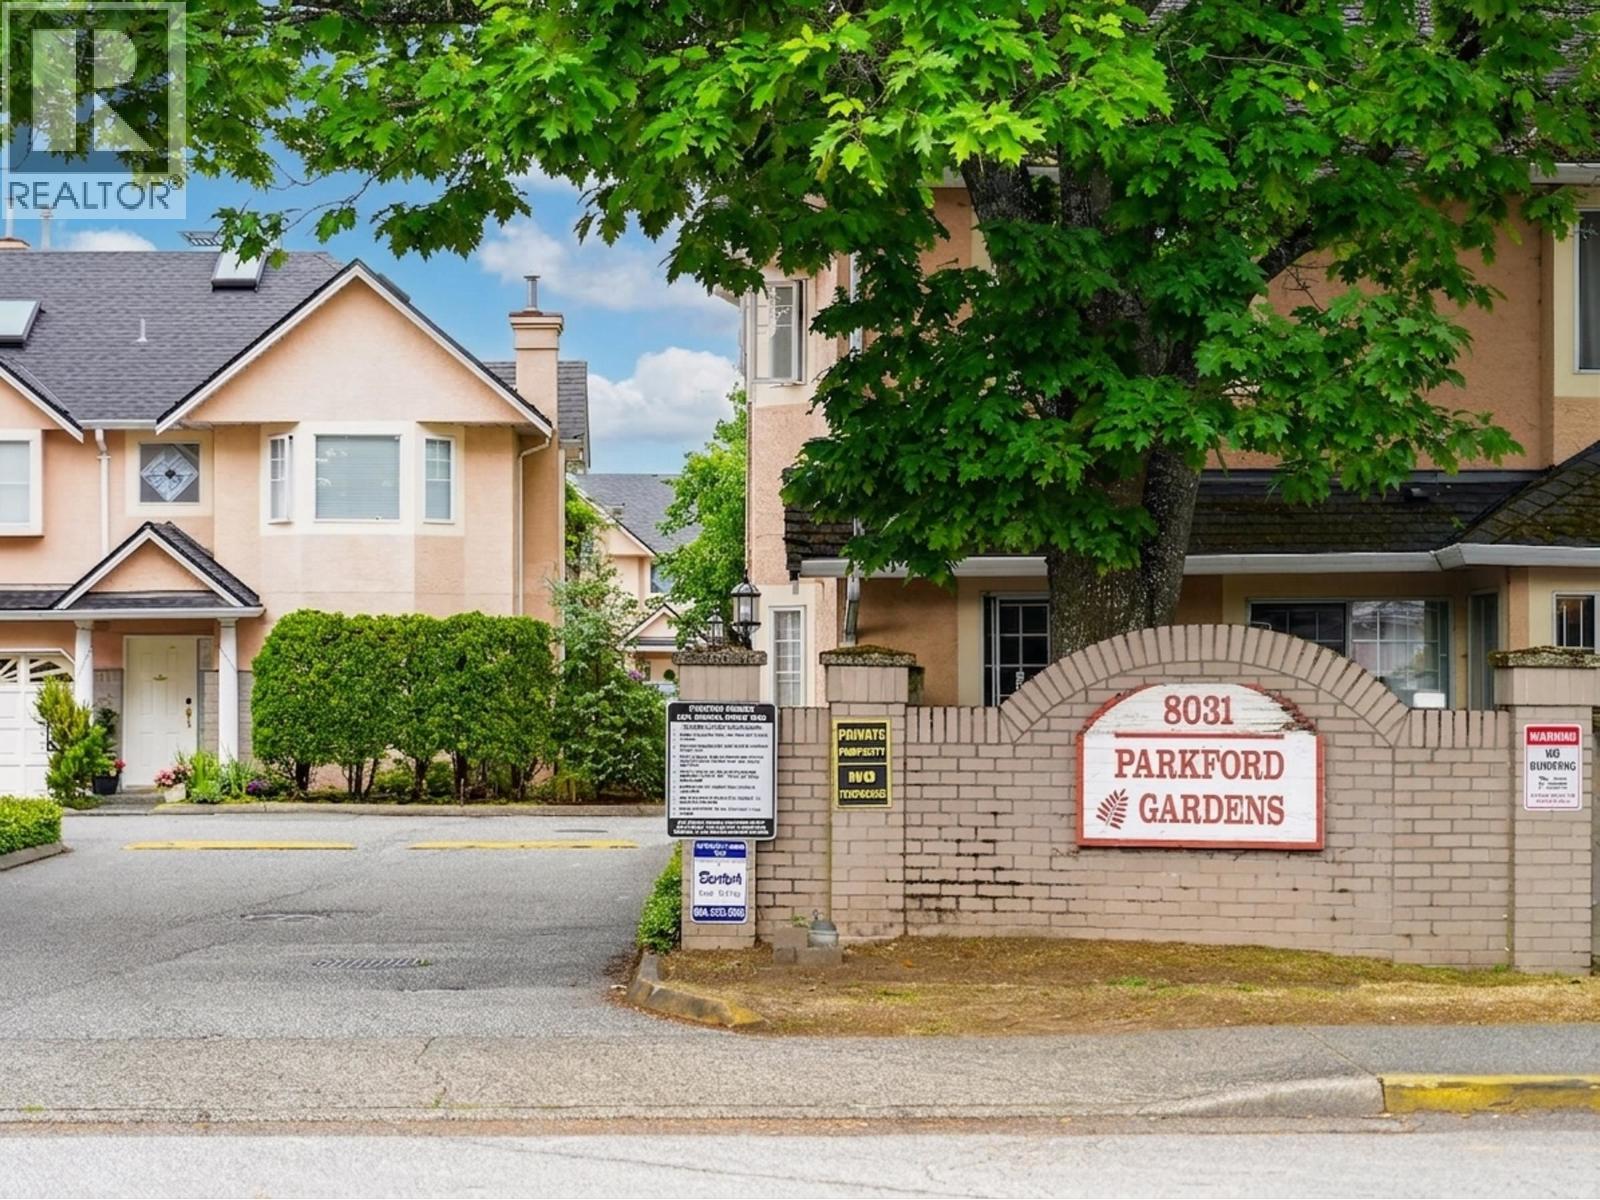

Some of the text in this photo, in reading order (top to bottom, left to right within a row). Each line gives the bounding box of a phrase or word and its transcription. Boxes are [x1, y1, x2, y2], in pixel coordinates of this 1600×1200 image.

[1163, 695, 1234, 726] 8031
[1114, 749, 1285, 781] PARKFORD
[1138, 792, 1285, 826] GARDENS
